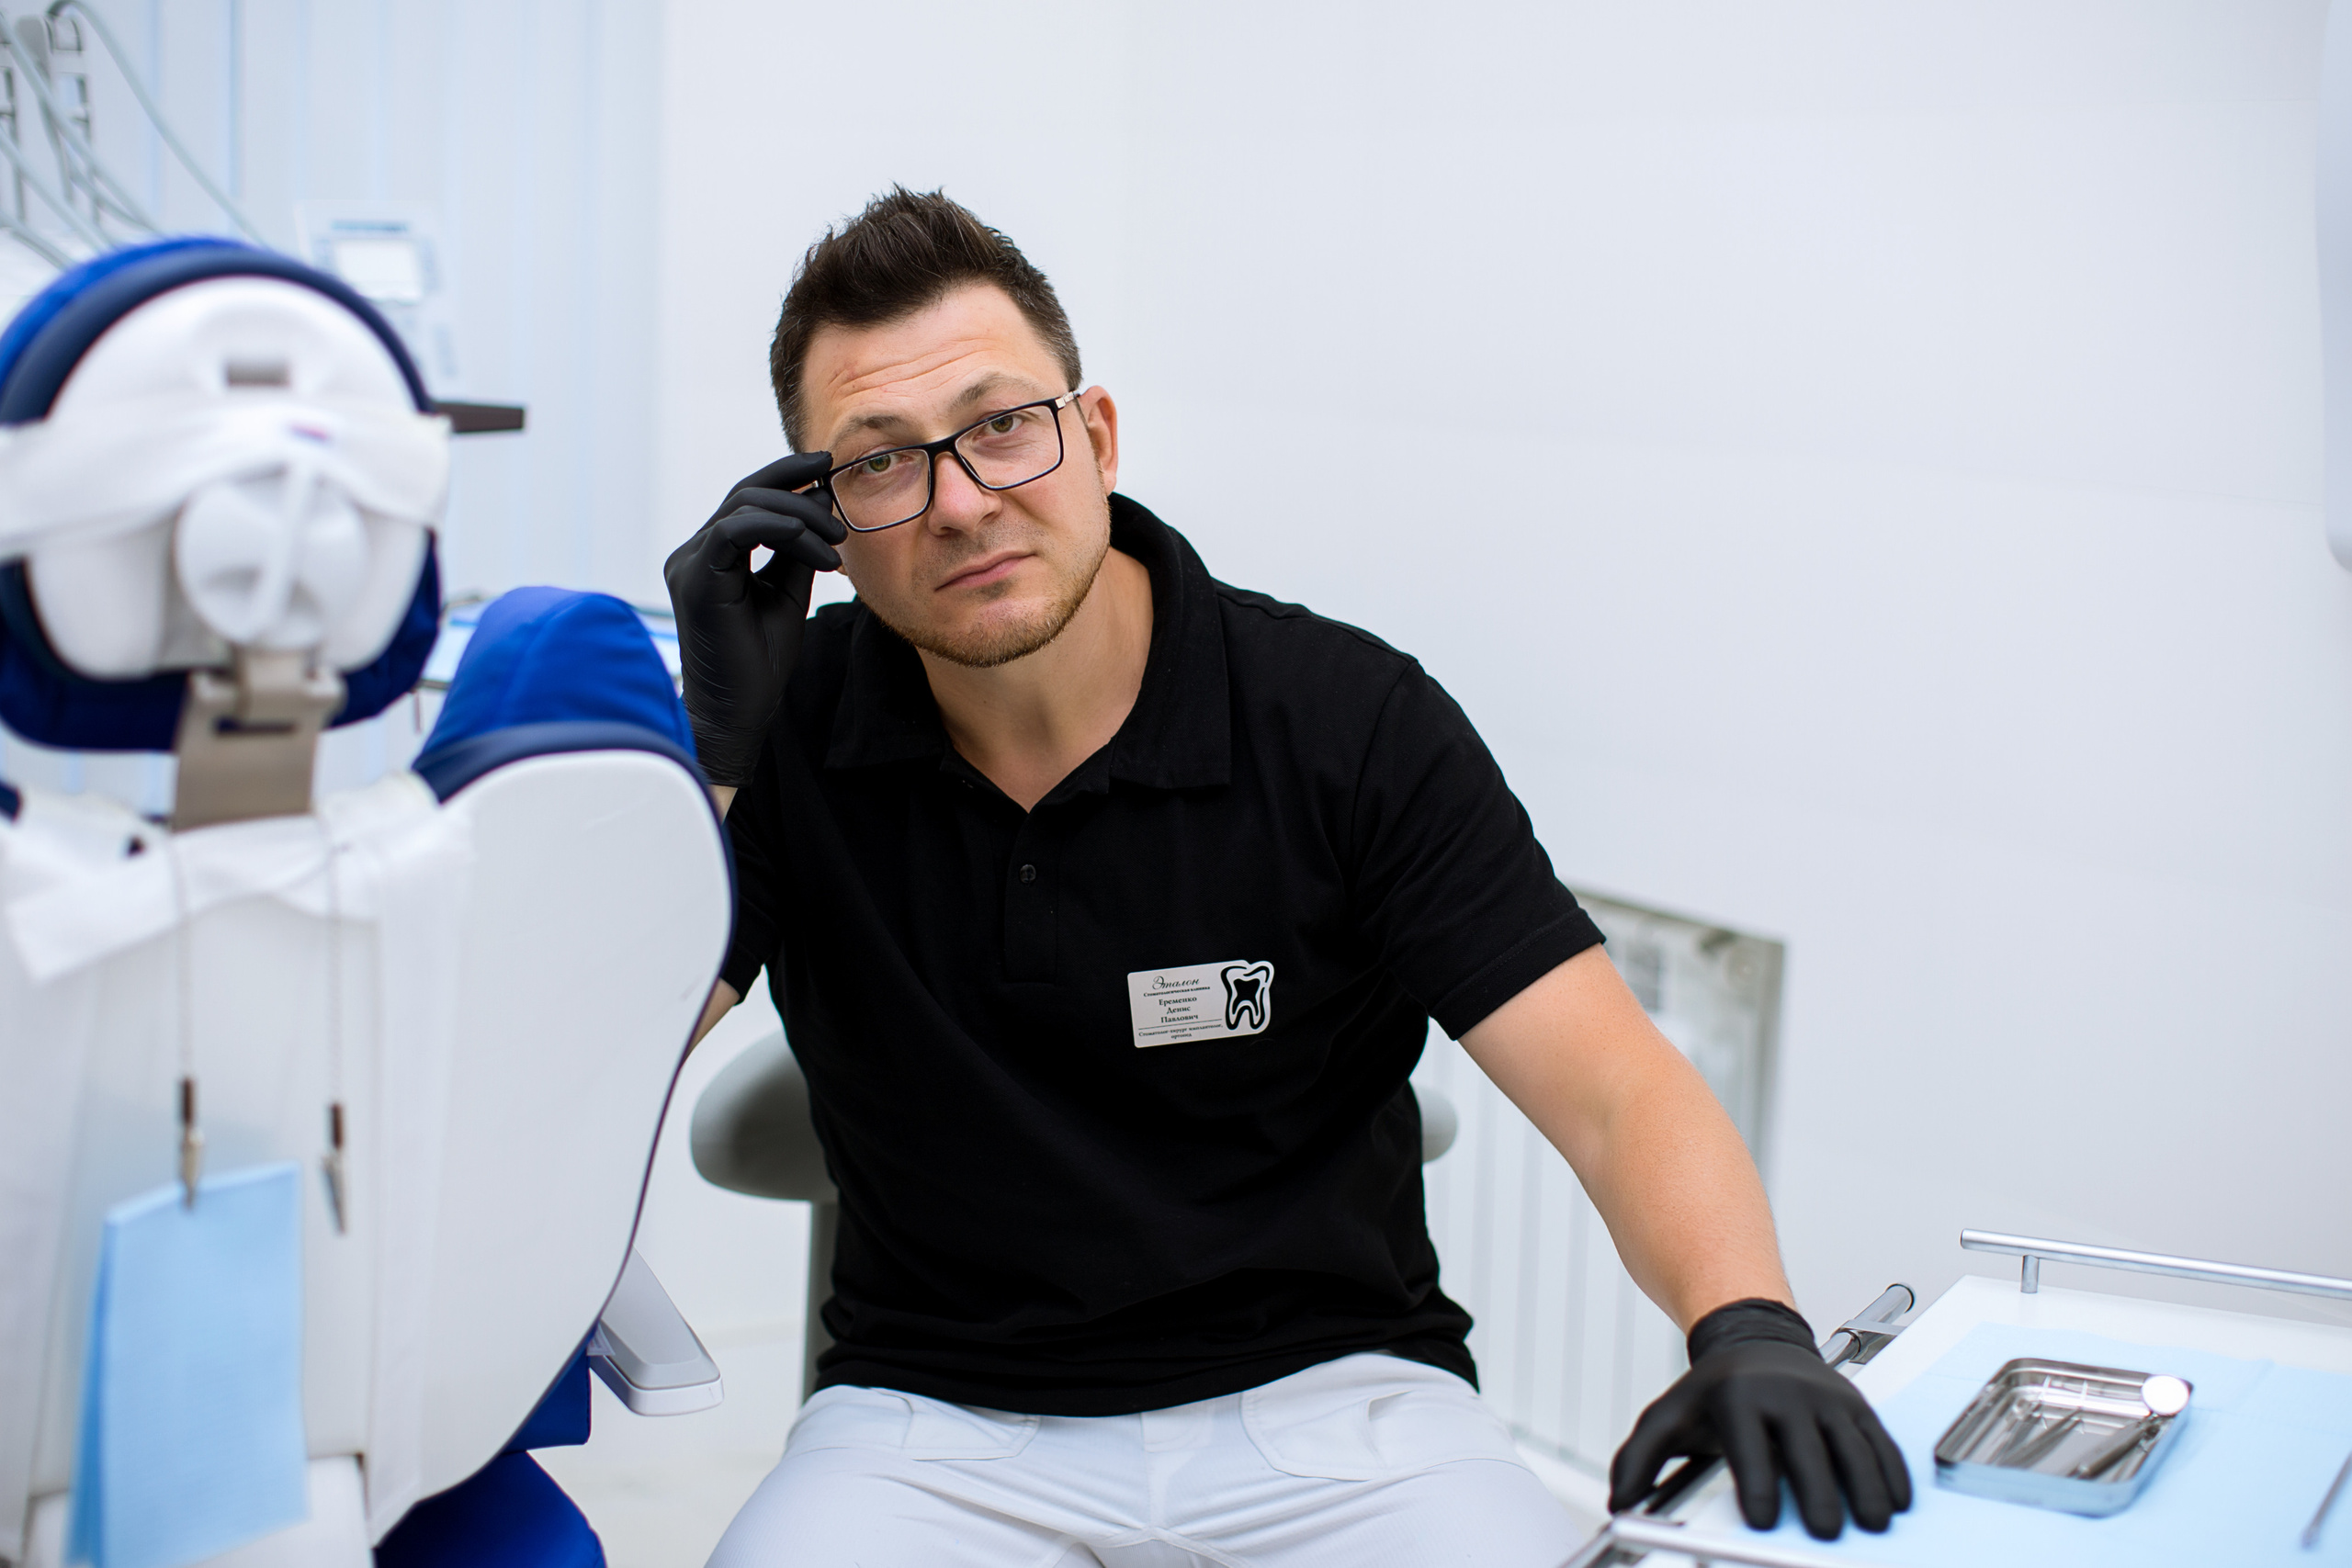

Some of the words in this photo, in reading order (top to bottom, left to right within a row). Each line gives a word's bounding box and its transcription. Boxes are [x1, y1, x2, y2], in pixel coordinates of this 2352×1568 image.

[1152, 976, 1200, 990] Эталон
[1159, 997, 1197, 1007] Еременко
[1166, 1006, 1191, 1015] Денис
[1160, 1014, 1199, 1023] Павлович
